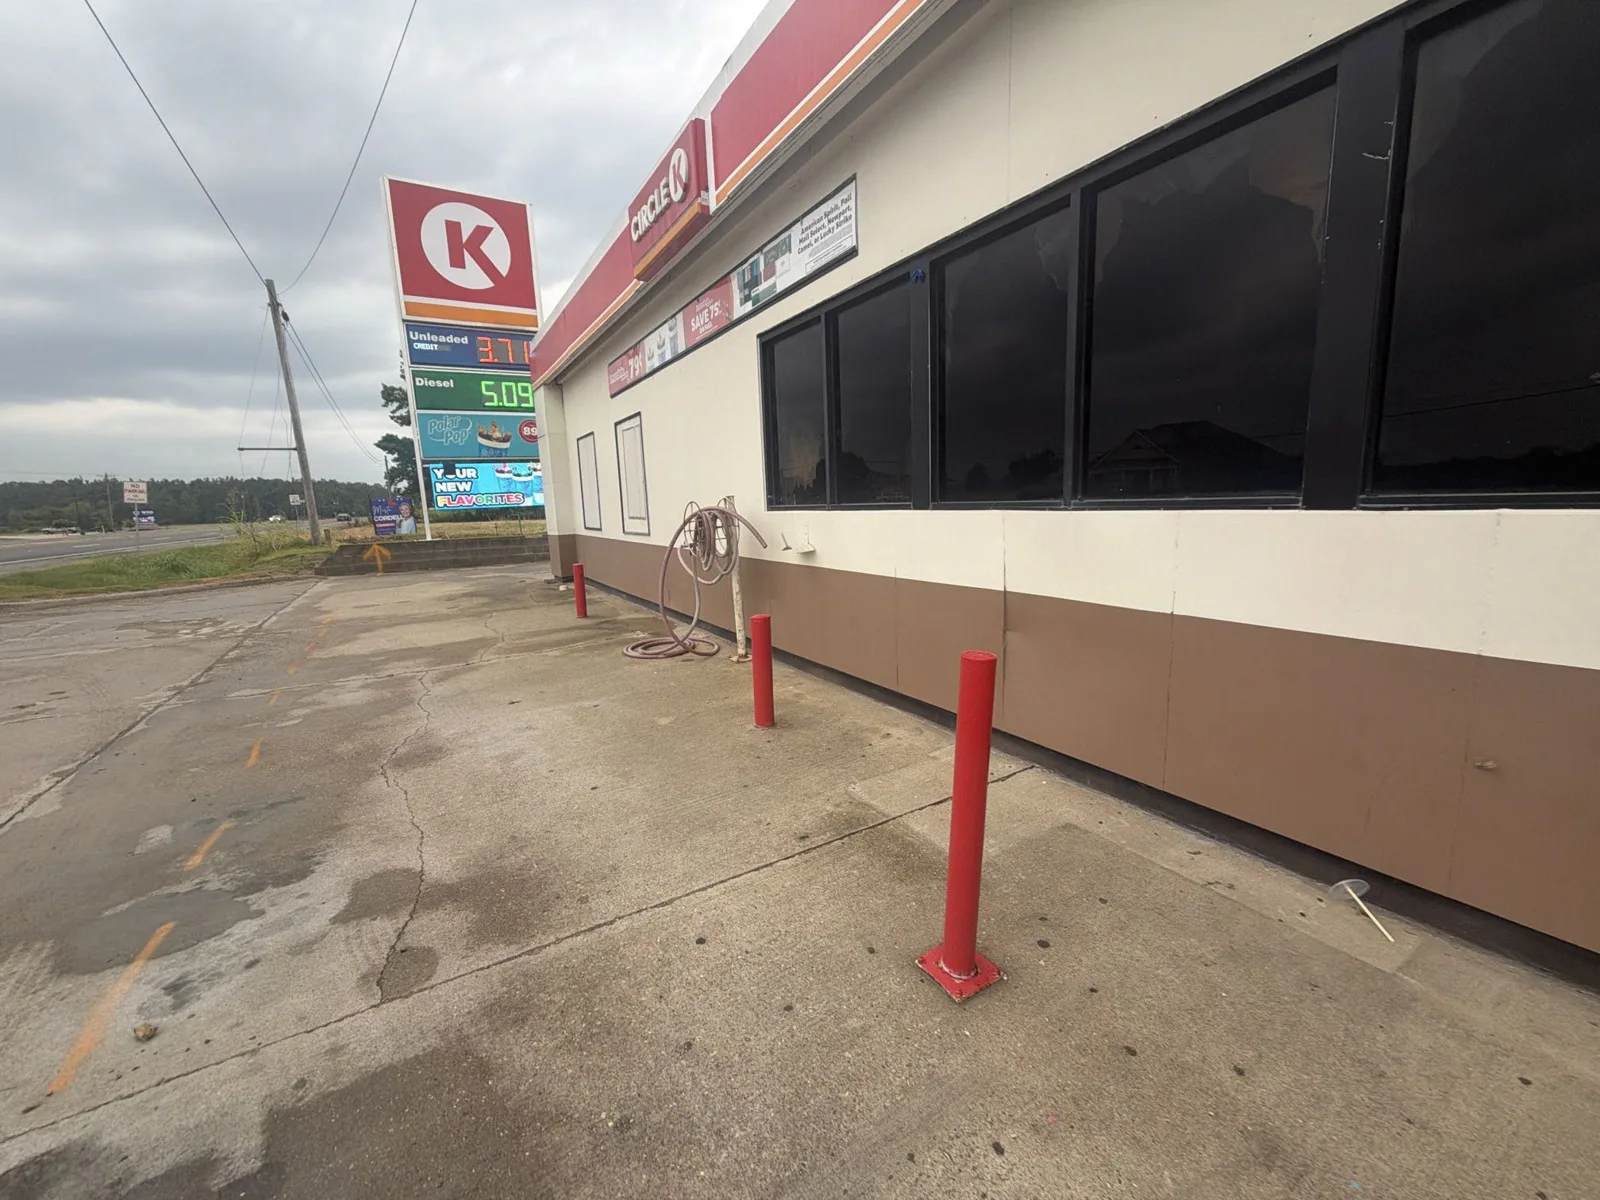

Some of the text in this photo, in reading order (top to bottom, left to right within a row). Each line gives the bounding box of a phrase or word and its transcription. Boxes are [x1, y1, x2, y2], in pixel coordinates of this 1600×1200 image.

[630, 148, 688, 242] CIRCLE K
[801, 215, 823, 235] American
[820, 225, 835, 241] Lucky
[836, 213, 852, 230] Strike
[690, 308, 709, 332] SAVE
[409, 331, 468, 345] Unleaded
[413, 342, 438, 351] CREDIT
[415, 377, 534, 408] Diesel 5.09
[427, 414, 461, 435] Polar
[443, 429, 469, 446] Pop
[432, 467, 478, 480] YUR
[435, 480, 473, 493] NEW
[436, 493, 524, 508] FLAVORITES
[373, 514, 405, 522] CORDELL
